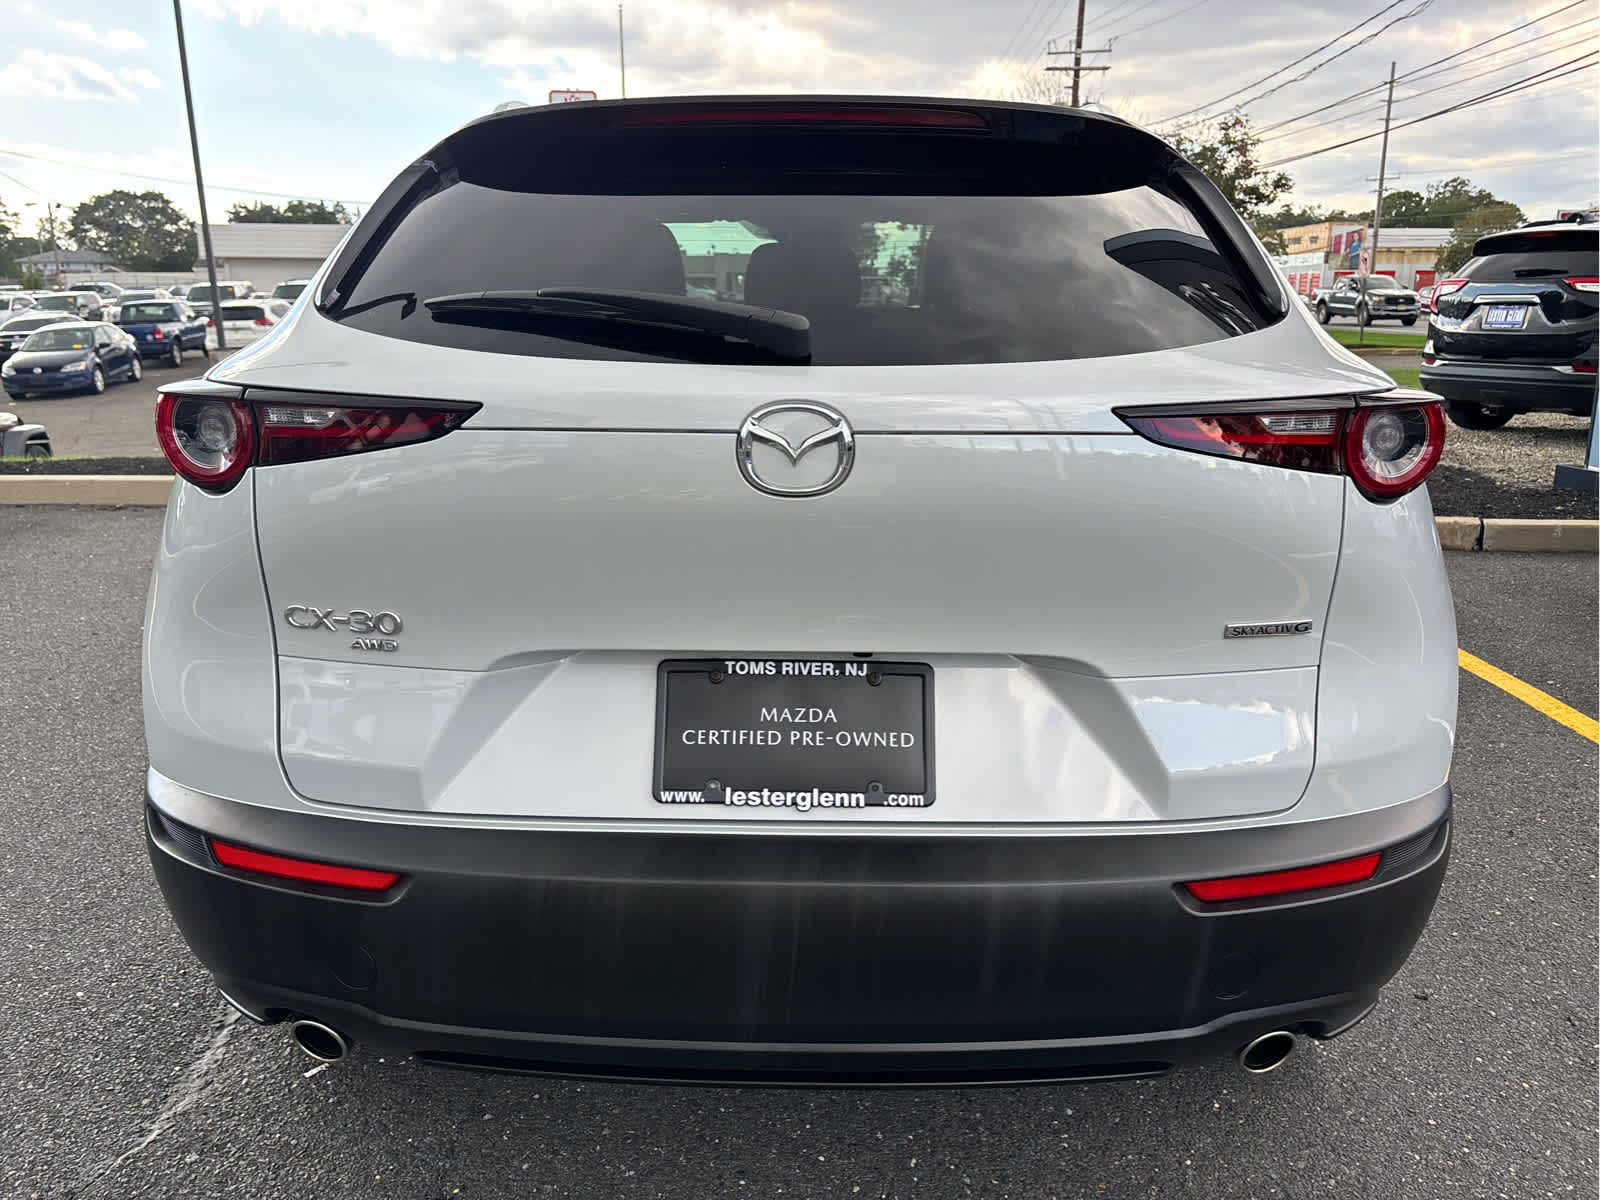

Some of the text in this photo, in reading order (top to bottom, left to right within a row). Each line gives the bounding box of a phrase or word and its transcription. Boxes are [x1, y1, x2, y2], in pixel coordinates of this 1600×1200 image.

[284, 605, 403, 635] CX-30
[350, 637, 398, 652] AWD
[725, 661, 868, 676] TOMS RIVER, NJ
[760, 708, 838, 723] MAZDA
[682, 730, 915, 748] CERTIFIED PRE-OWNED
[724, 787, 865, 811] lesterglenn
